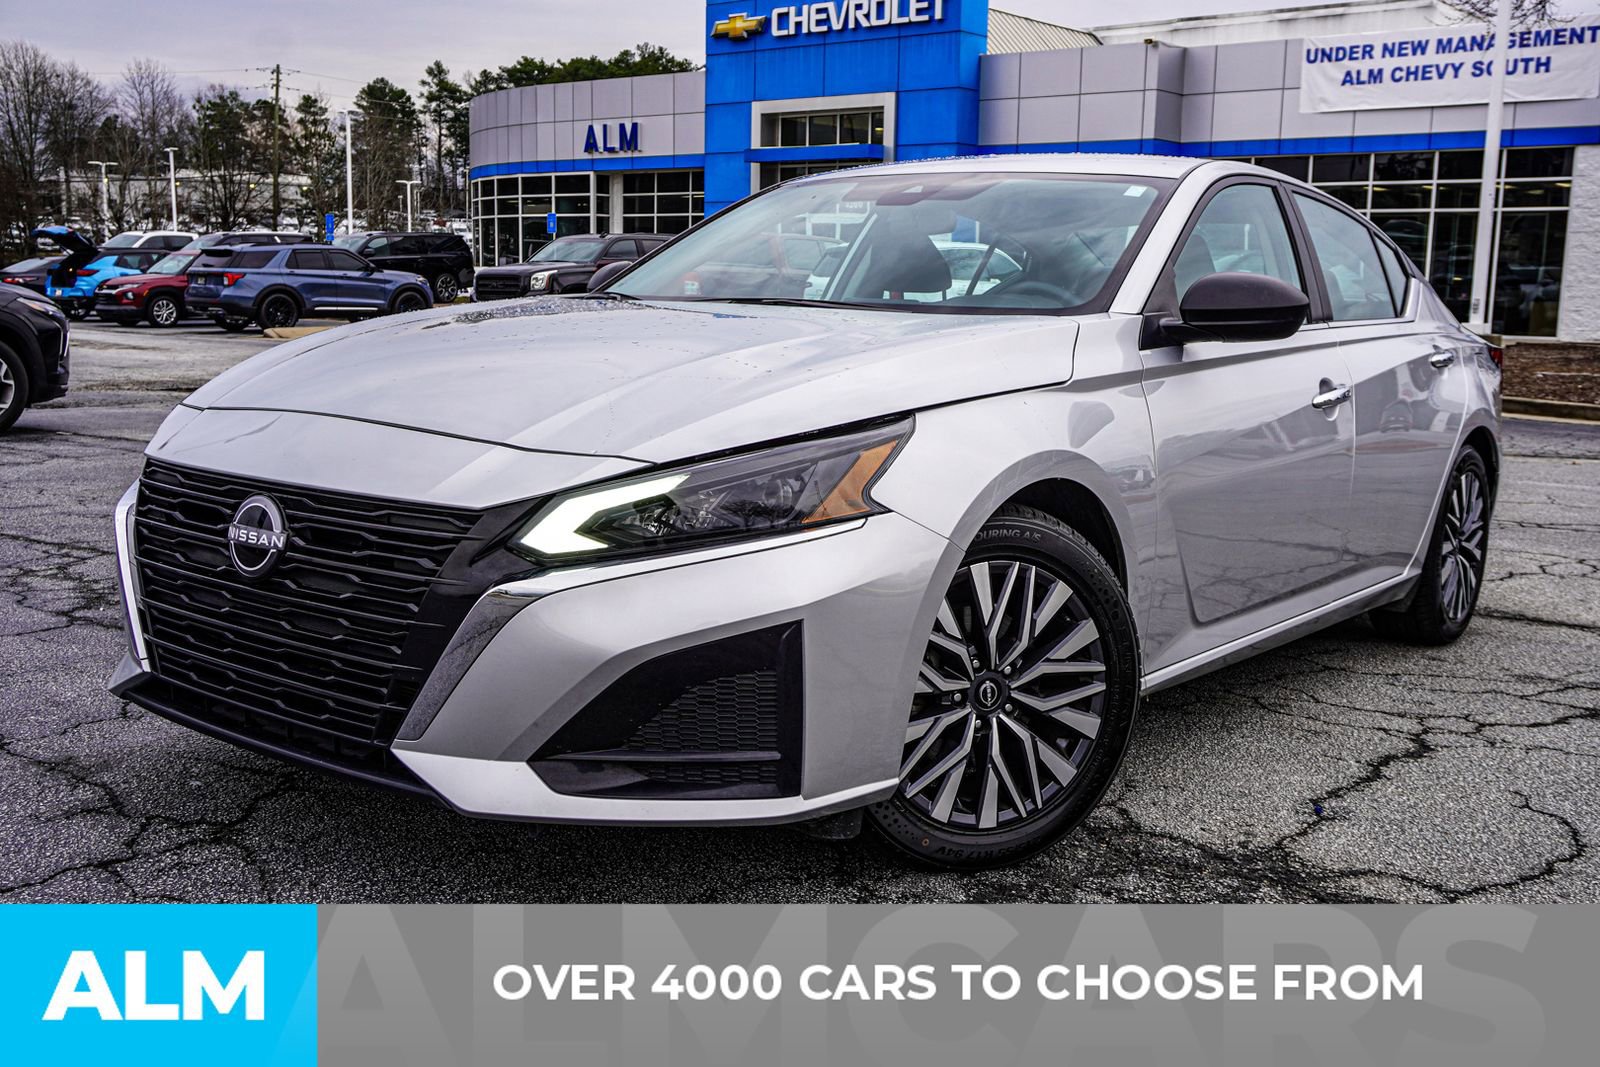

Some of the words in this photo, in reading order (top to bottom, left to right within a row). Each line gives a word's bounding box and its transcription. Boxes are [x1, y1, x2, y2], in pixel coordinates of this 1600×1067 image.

[1305, 44, 1375, 64] UNDER
[1381, 39, 1430, 59] NEW
[1341, 68, 1384, 87] ALM
[1391, 62, 1465, 83] CHEVY
[583, 122, 639, 153] ALM
[228, 526, 284, 548] NISSAN
